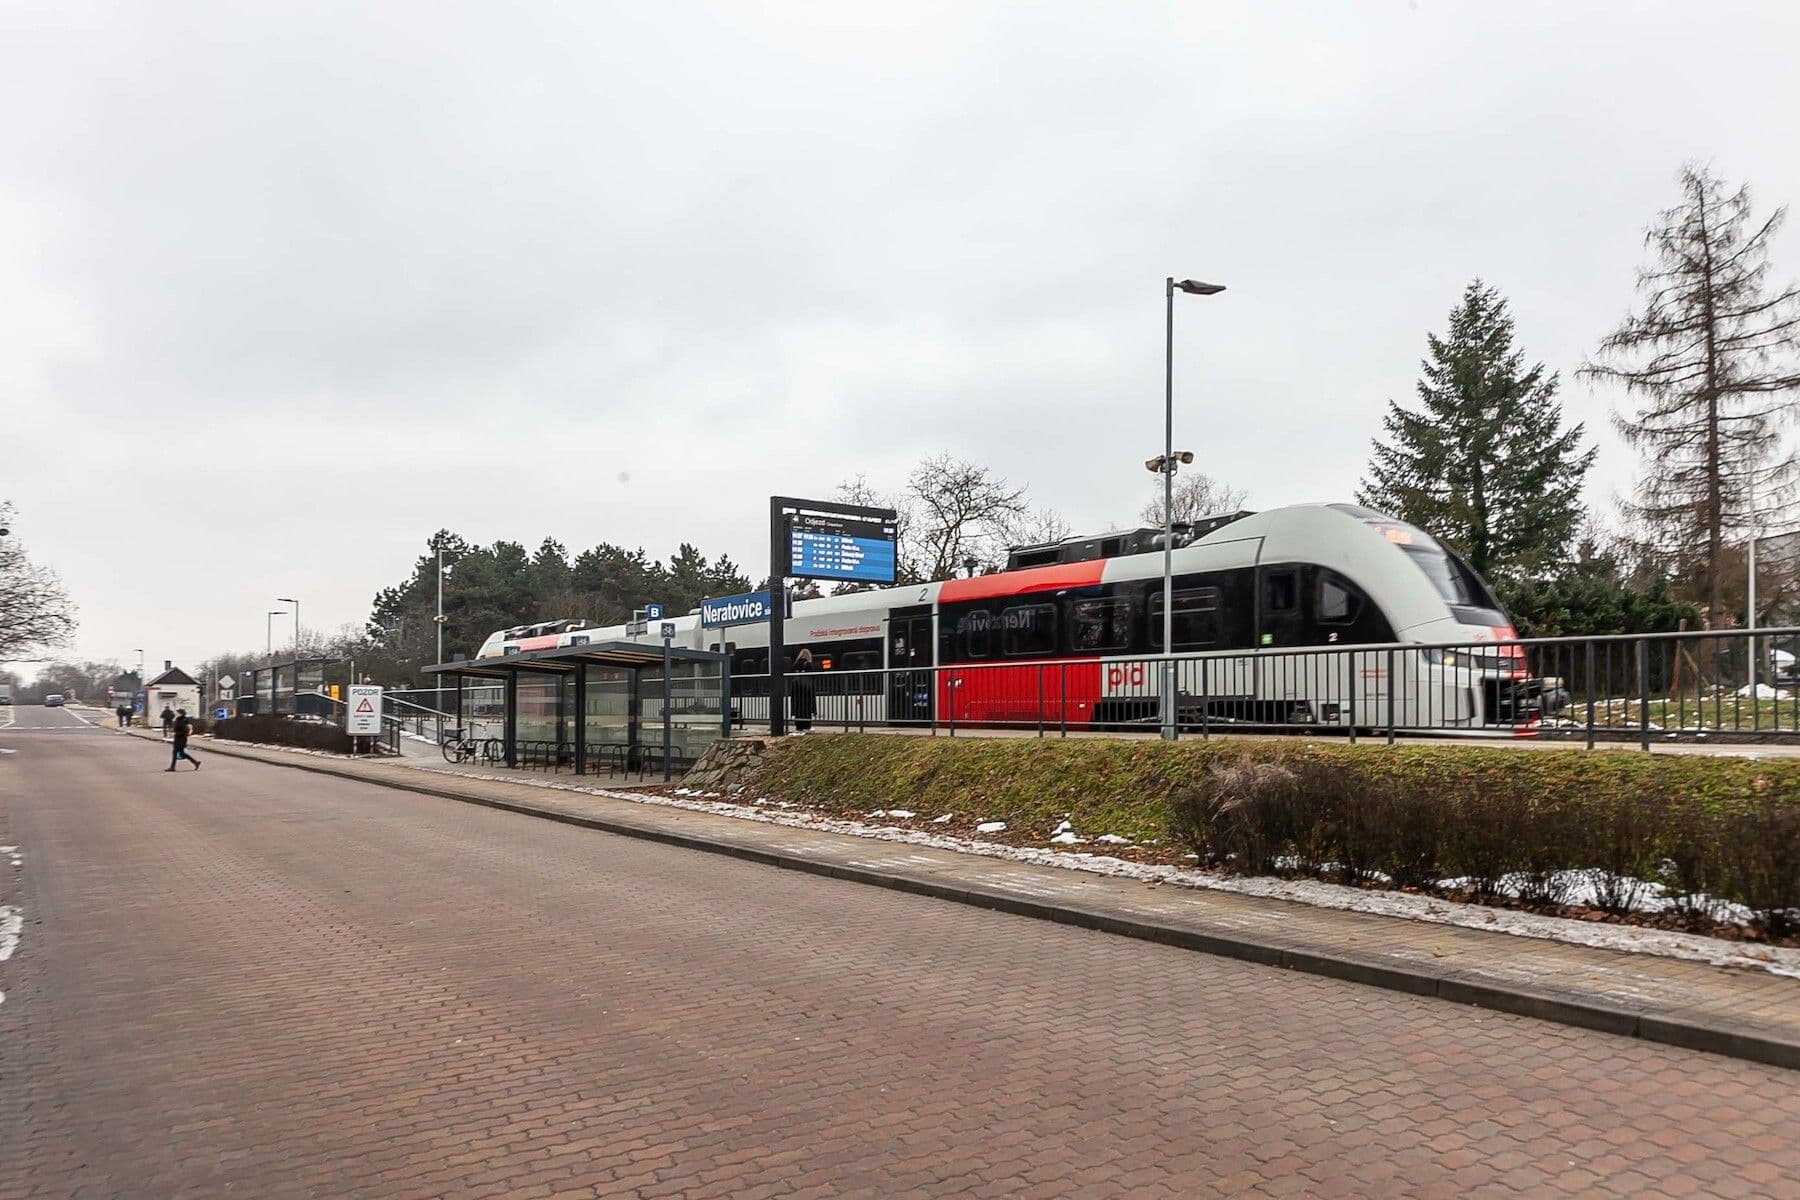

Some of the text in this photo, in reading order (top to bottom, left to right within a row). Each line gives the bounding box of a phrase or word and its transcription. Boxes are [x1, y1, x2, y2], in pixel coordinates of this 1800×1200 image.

[918, 587, 929, 602] 2
[650, 607, 660, 618] B
[703, 599, 762, 624] Neratovice
[1328, 632, 1338, 642] 2
[352, 688, 379, 696] POZOR
